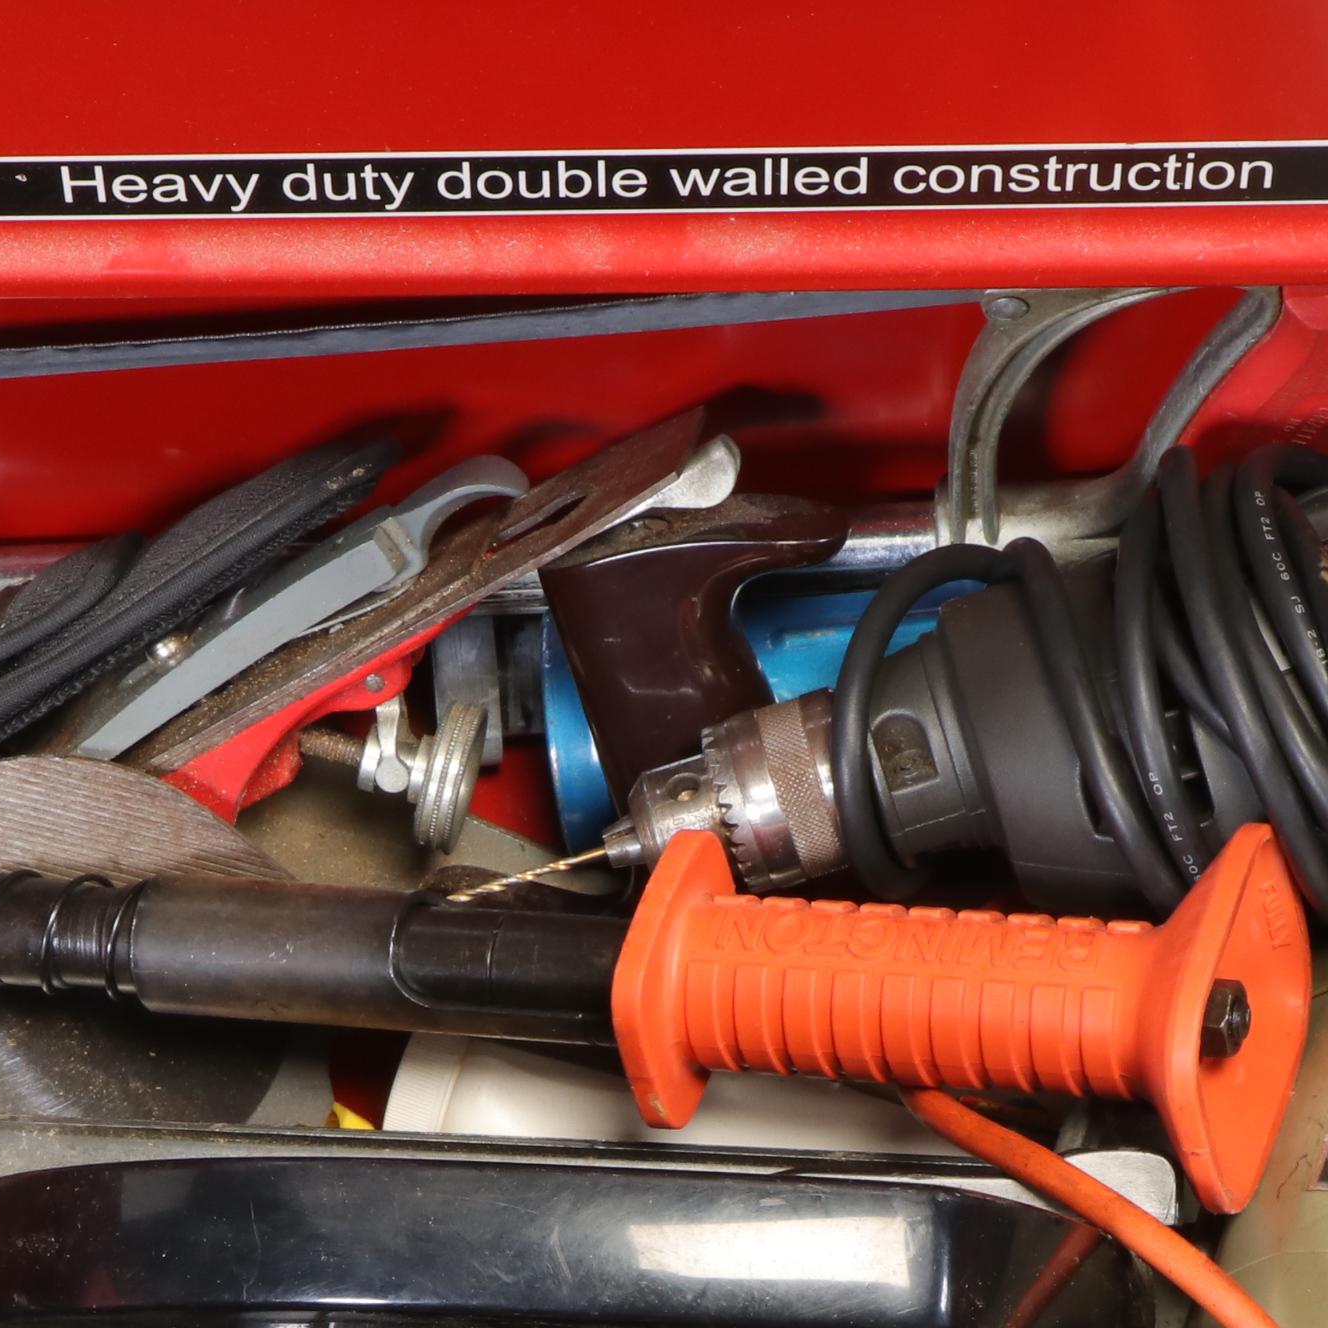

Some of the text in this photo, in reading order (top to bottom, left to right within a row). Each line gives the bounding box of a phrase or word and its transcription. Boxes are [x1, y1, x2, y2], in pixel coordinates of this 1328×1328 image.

[61, 154, 1274, 212] Heavy duty double walled construction
[1259, 515, 1276, 542] FT2
[1289, 595, 1306, 615] SJ
[1148, 770, 1184, 843] FT2 OP
[713, 908, 1101, 973] REMINGTON
